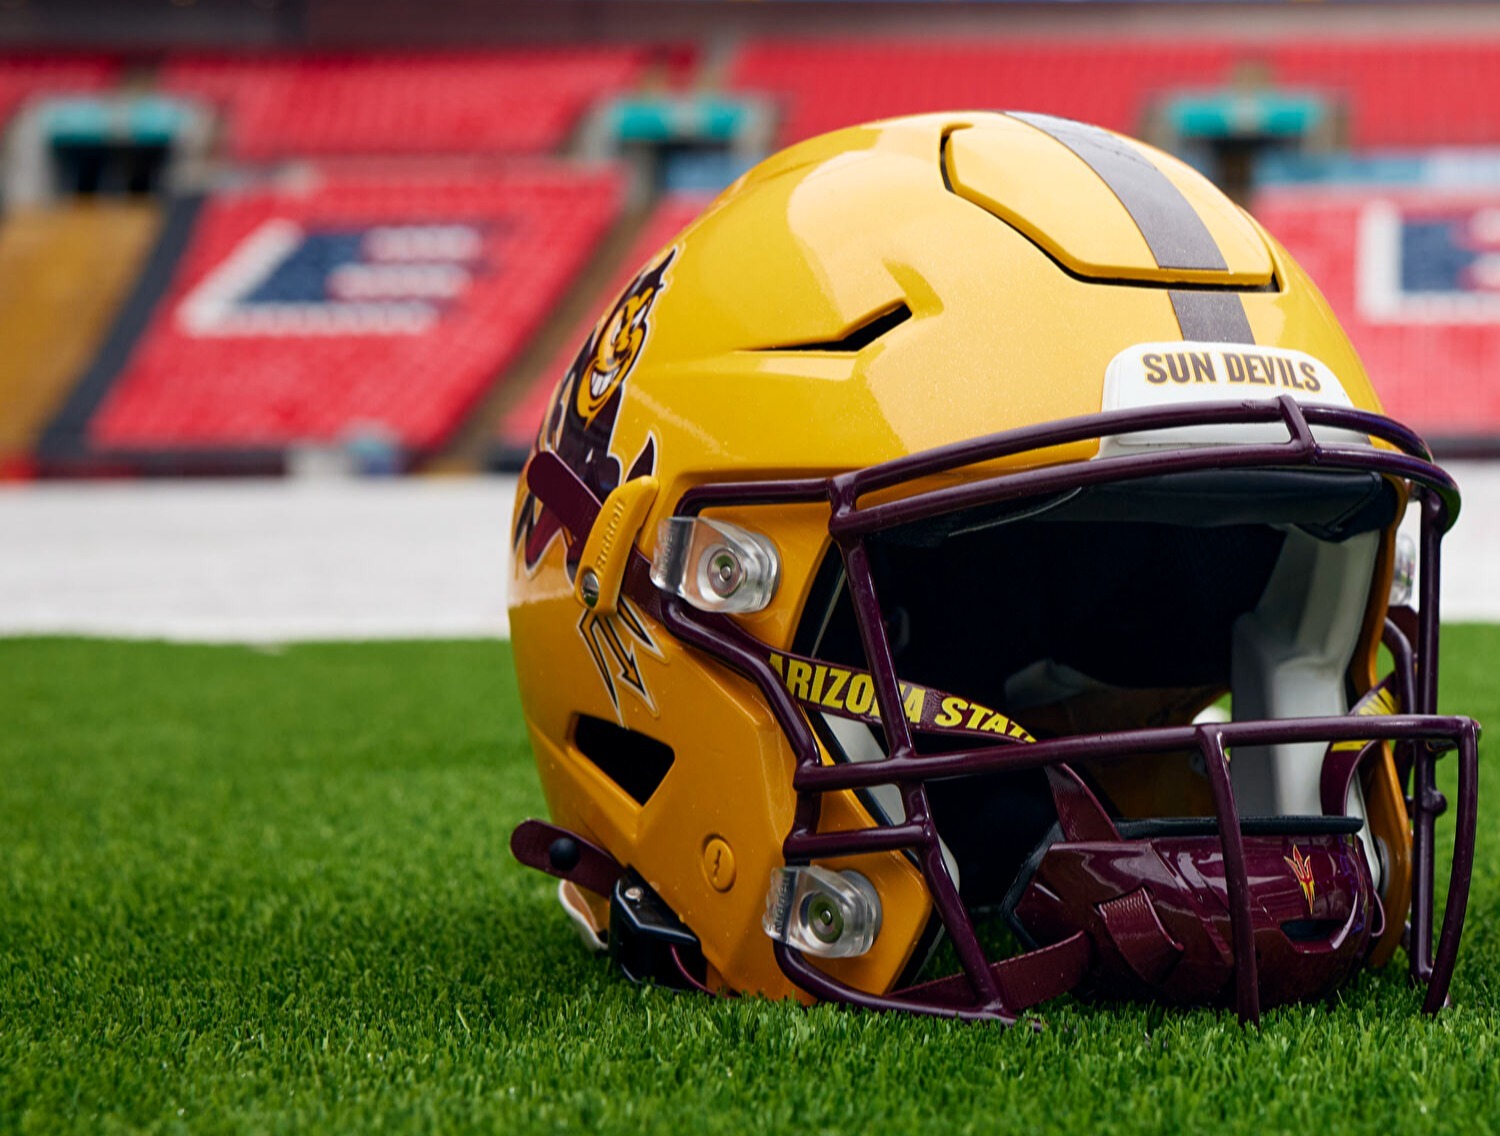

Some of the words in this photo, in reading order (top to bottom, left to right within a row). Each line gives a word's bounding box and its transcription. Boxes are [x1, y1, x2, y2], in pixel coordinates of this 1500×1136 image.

[1141, 351, 1217, 384] SUN
[1221, 351, 1322, 393] DEVILS
[934, 696, 1037, 743] STAT
